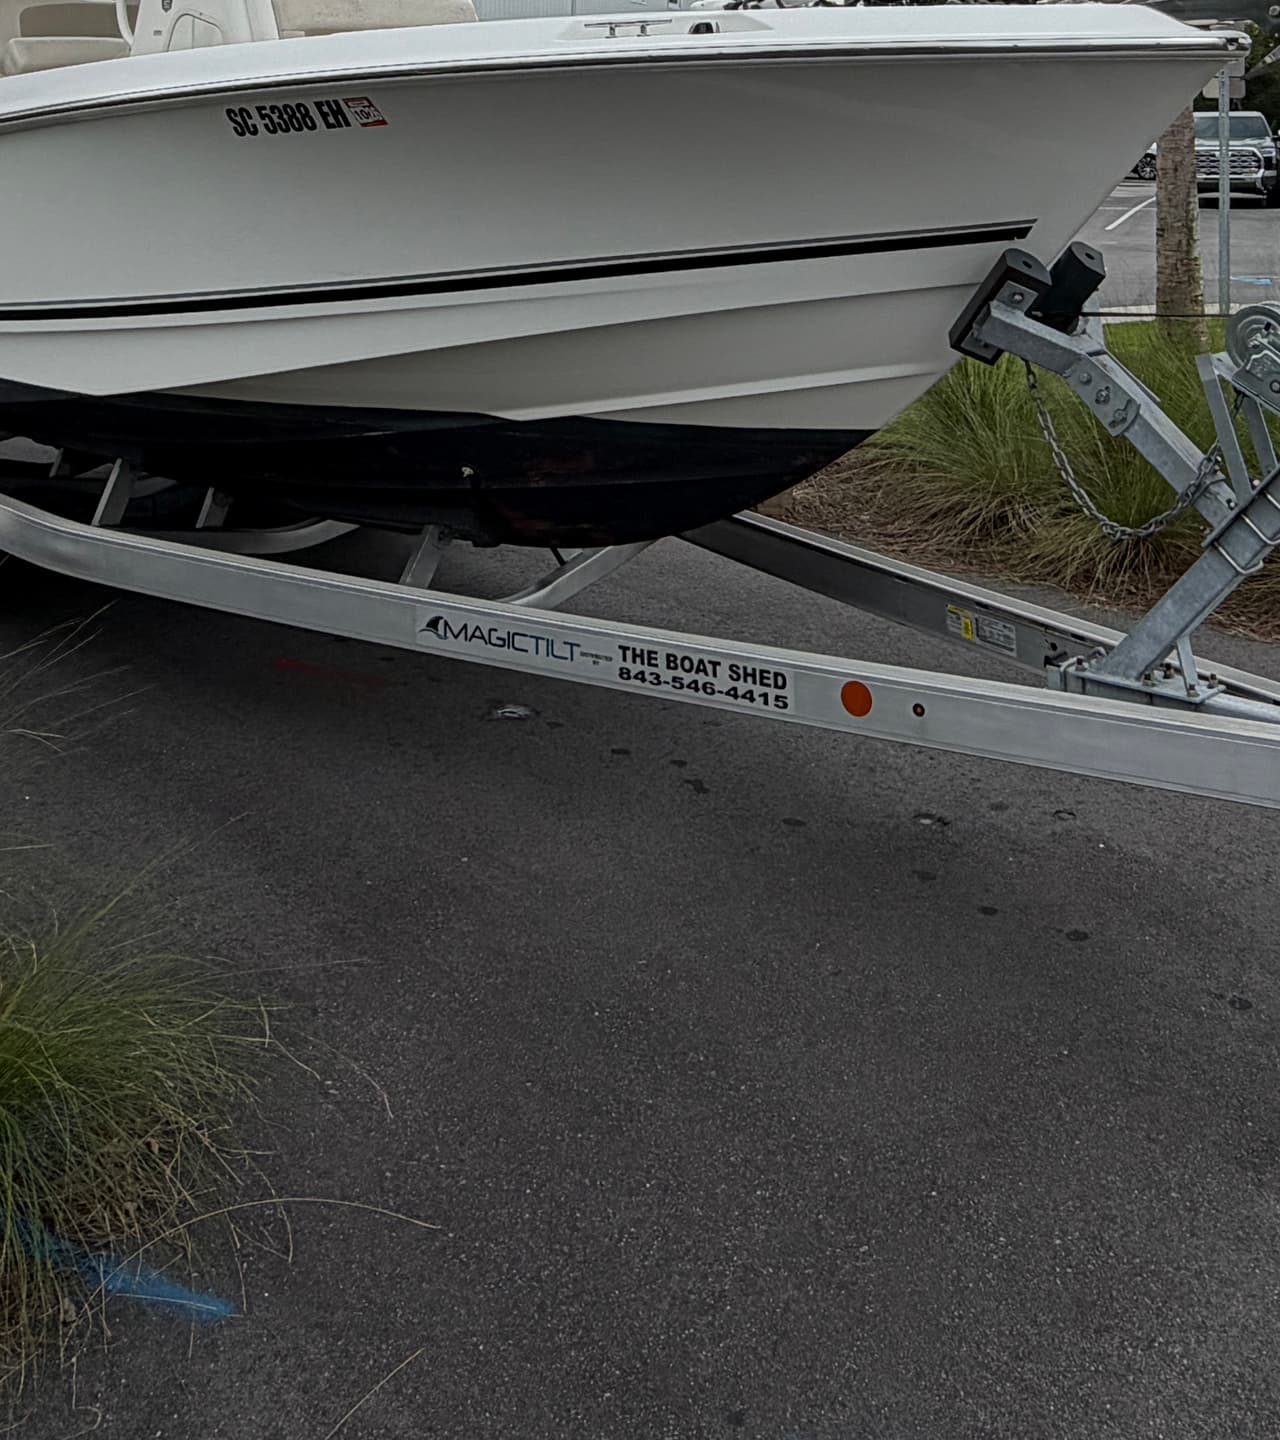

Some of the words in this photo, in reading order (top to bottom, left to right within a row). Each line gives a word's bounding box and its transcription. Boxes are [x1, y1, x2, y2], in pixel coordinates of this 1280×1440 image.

[225, 107, 258, 137] SC
[255, 102, 318, 135] 5388
[313, 99, 352, 130] EH
[443, 619, 581, 662] MAGICTILT
[617, 644, 659, 668] THE
[665, 652, 722, 678] BOAT
[728, 663, 787, 690] SHED
[617, 666, 789, 710] 843-546-4415
